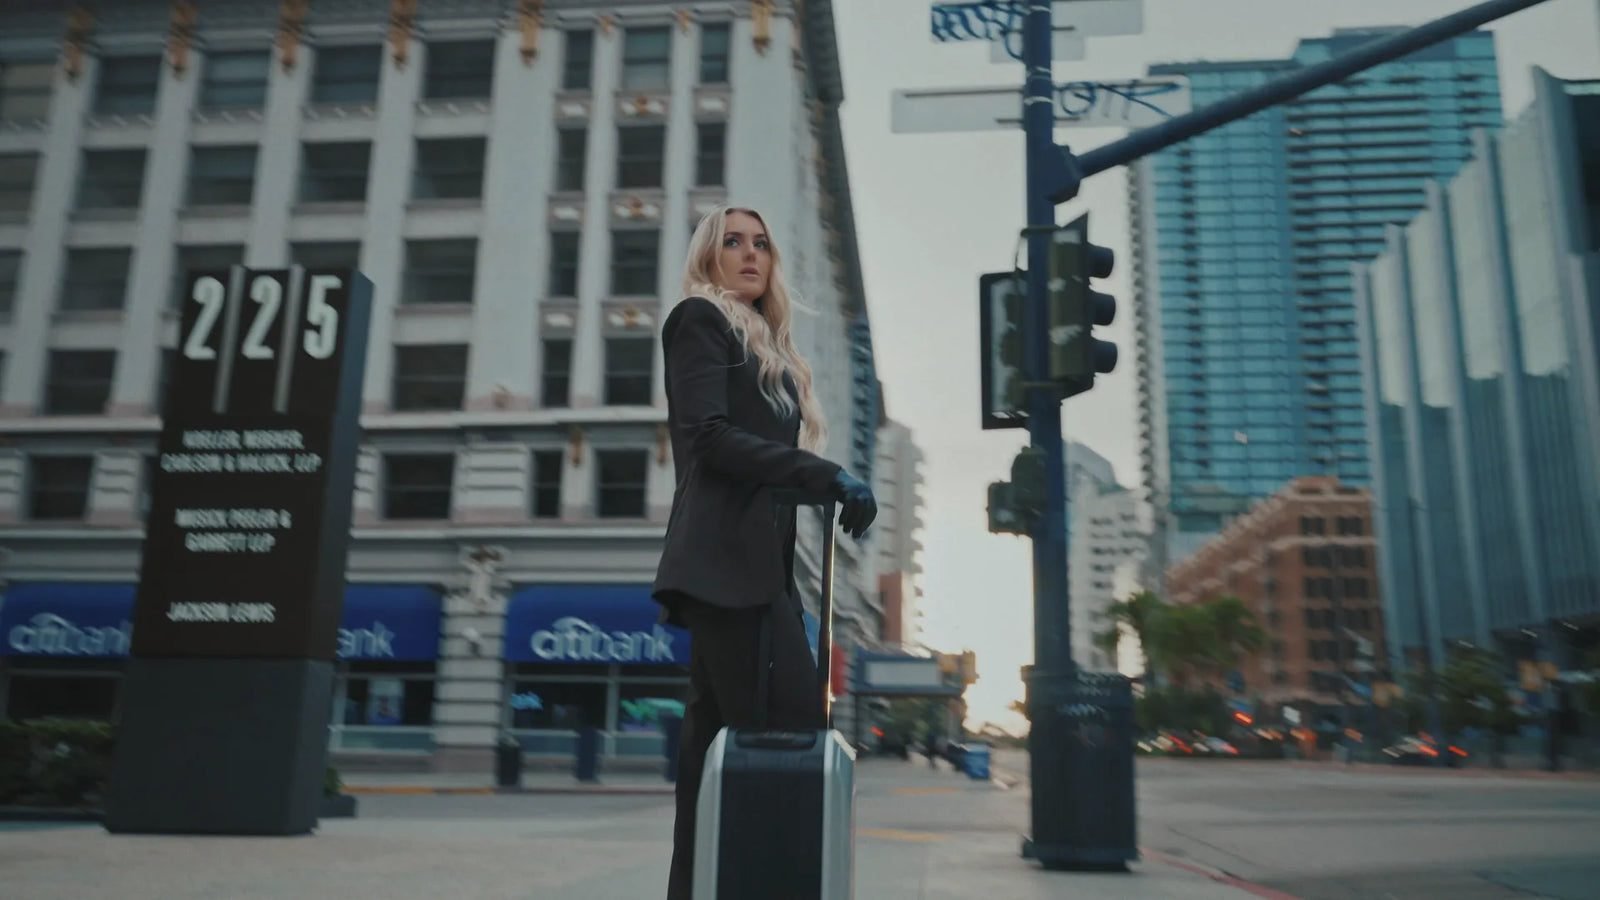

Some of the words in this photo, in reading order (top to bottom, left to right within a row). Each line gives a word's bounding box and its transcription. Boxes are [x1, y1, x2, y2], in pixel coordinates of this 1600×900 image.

[183, 275, 342, 360] 225
[166, 602, 229, 622] JACKSON
[229, 602, 276, 623] LEWIS
[336, 621, 395, 657] ank
[530, 616, 675, 661] citibank
